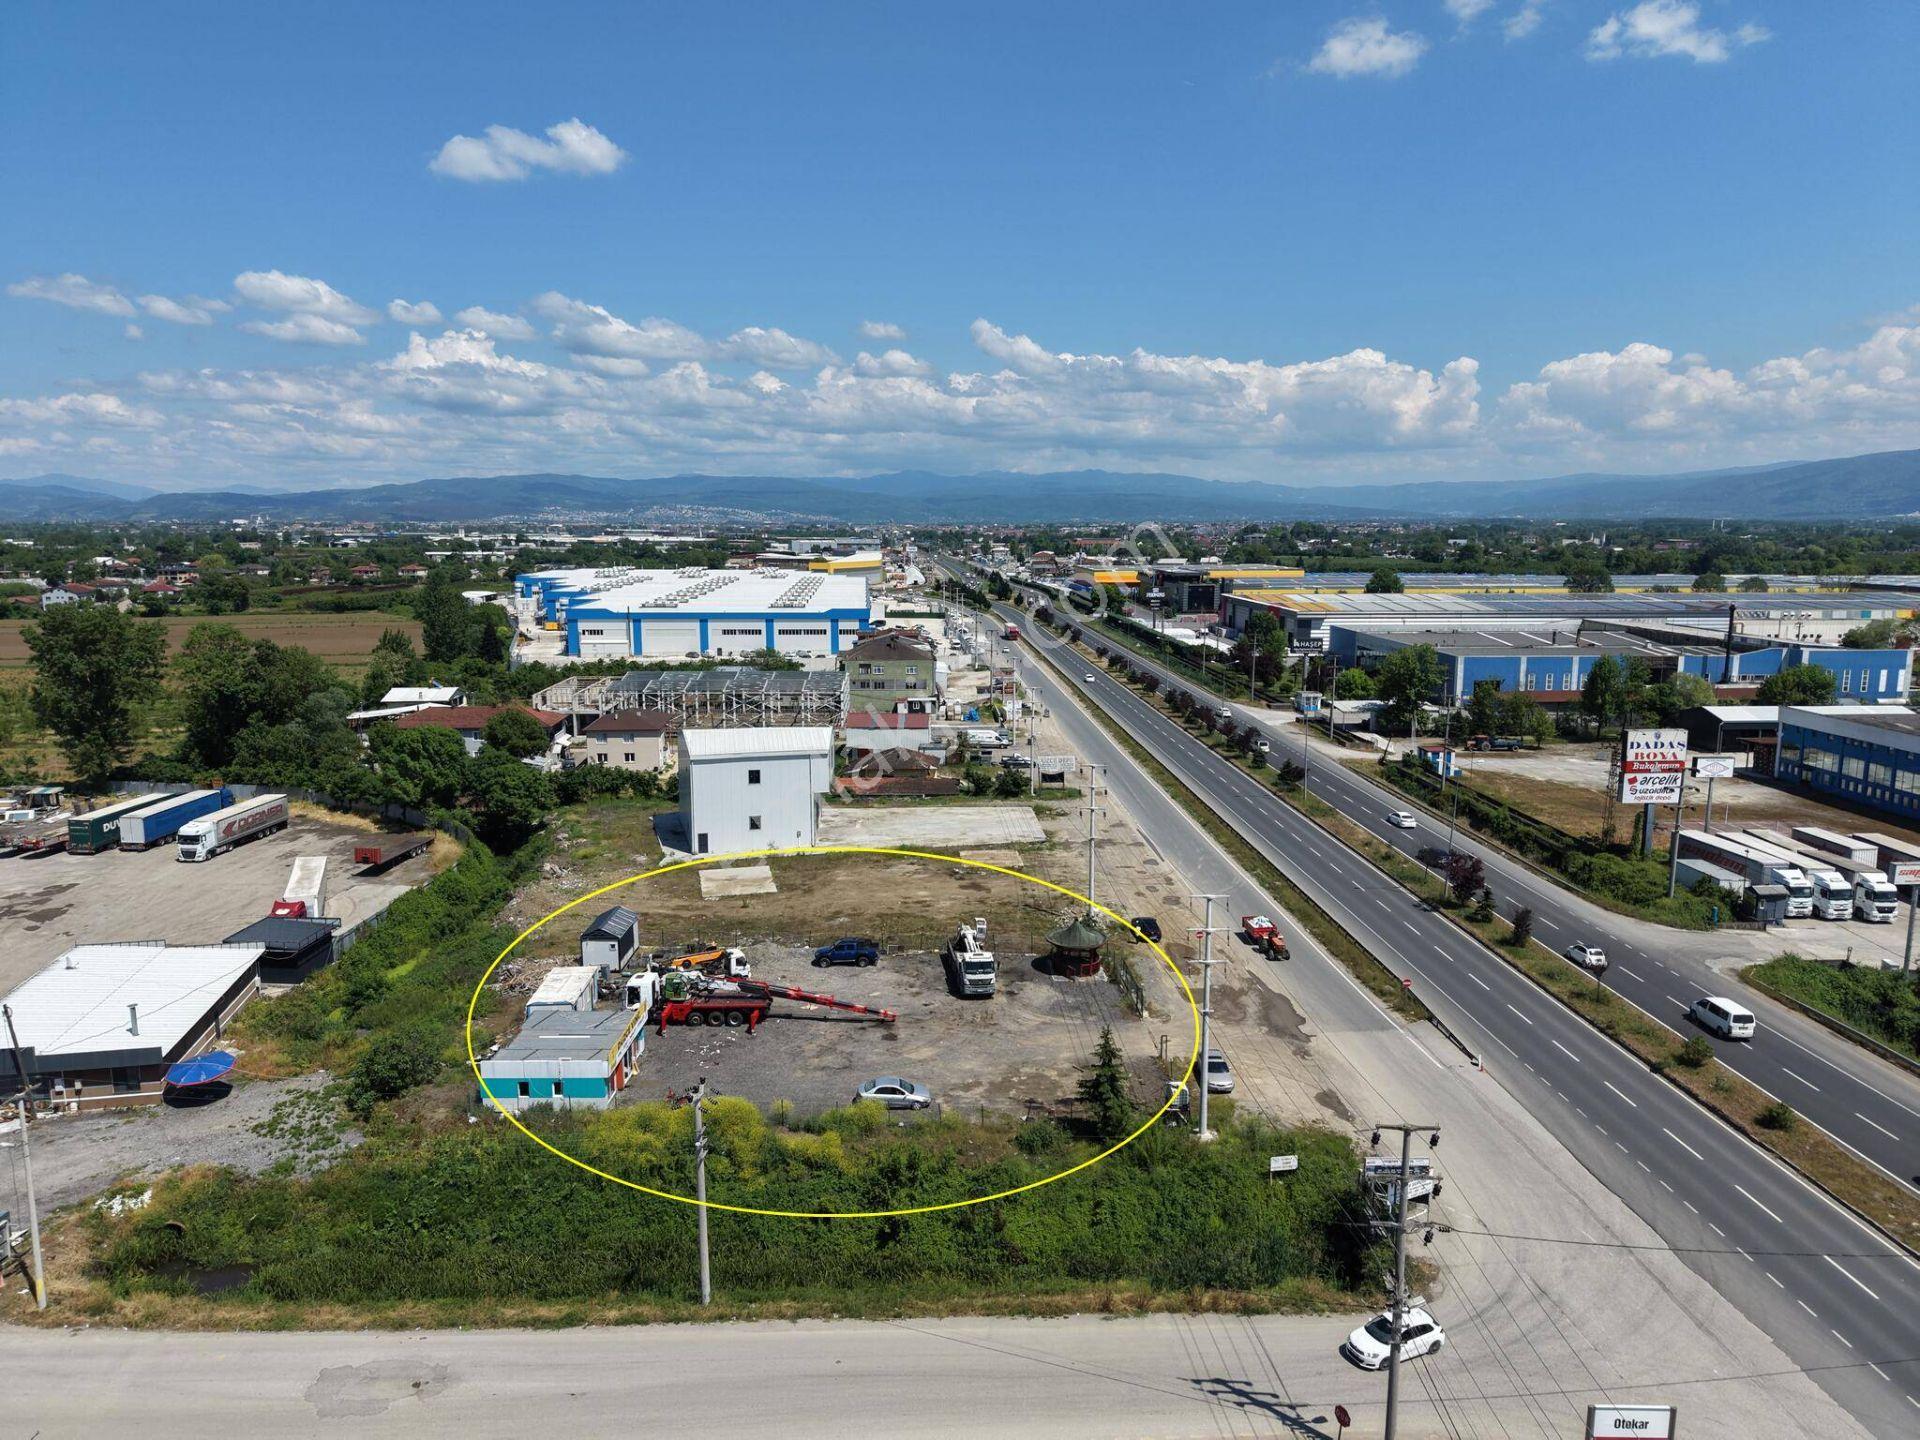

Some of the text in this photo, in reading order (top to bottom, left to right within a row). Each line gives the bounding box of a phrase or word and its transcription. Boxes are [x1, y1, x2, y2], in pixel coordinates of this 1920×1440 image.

[1629, 741, 1686, 751] DADAŞ
[1634, 752, 1678, 760] BOYA
[1640, 774, 1680, 787] arçelik
